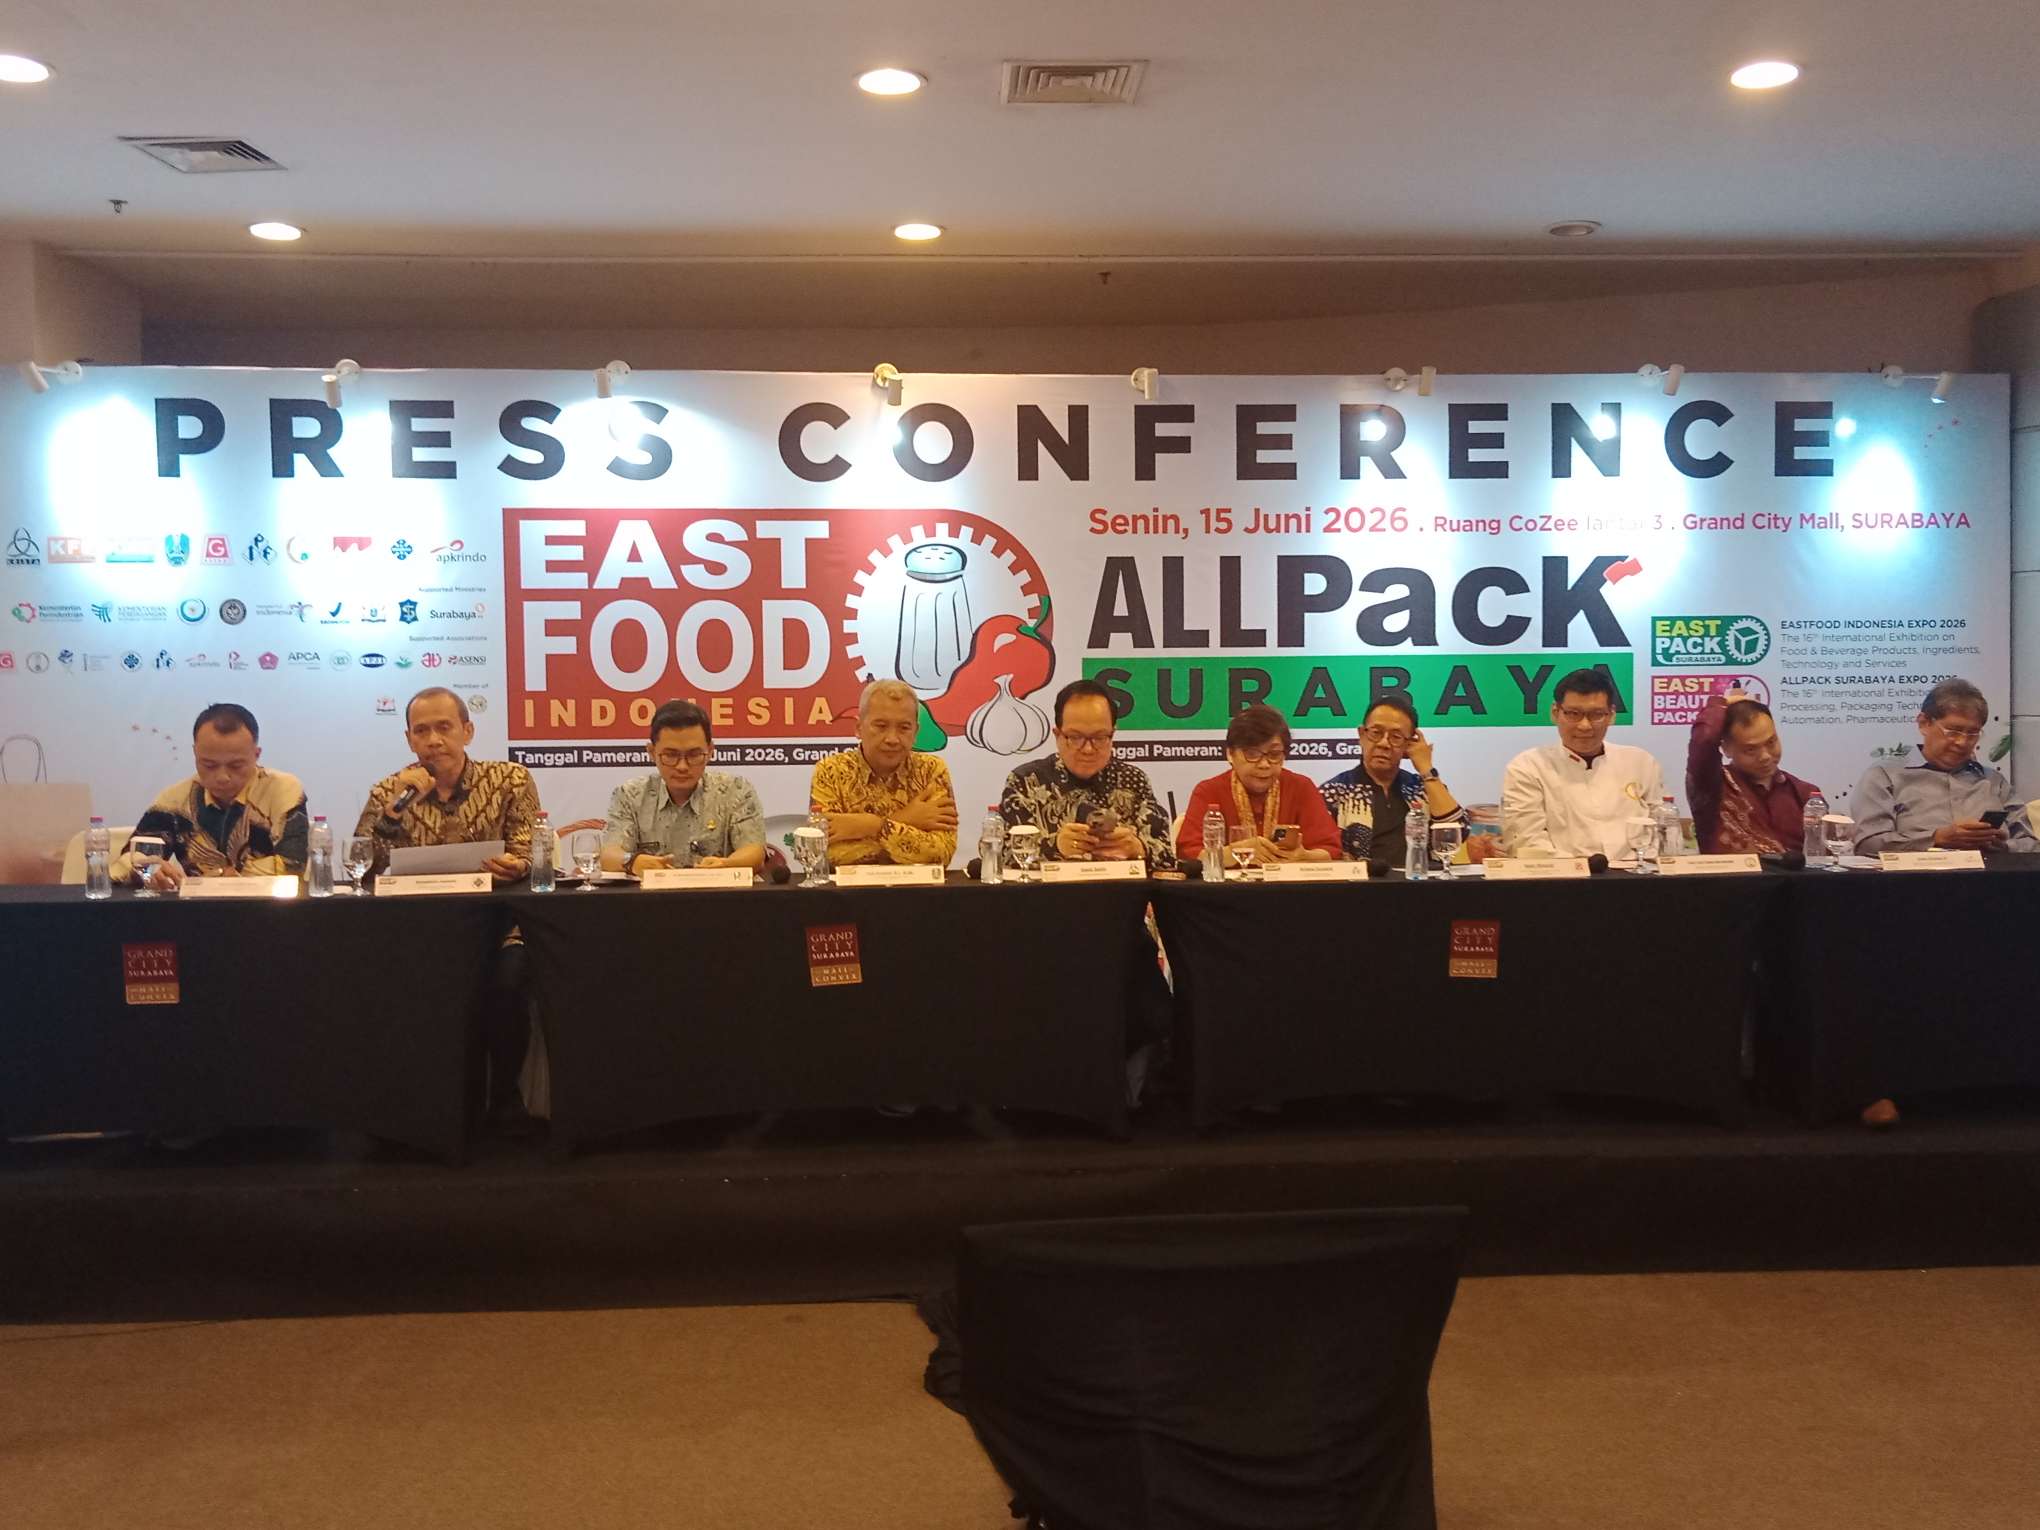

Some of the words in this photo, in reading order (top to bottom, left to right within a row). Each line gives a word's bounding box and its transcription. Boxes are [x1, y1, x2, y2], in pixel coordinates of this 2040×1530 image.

[155, 397, 673, 480] PRESS
[778, 400, 1835, 482] CONFERENCE
[1089, 507, 1189, 540] Senin,
[1199, 507, 1233, 535] 15
[1243, 506, 1311, 535] Juni
[1322, 506, 1409, 534] 2026
[1434, 515, 1501, 535] Ruang
[1508, 515, 1579, 532] CoZee
[1682, 512, 1745, 531] Grand
[1752, 512, 1792, 532] City
[1799, 512, 1845, 532] Mall,
[1852, 512, 1971, 529] SURABAYA
[436, 552, 487, 564] apkrindo
[519, 519, 830, 590] EAST
[430, 609, 477, 620] Surabaya
[1655, 620, 1722, 637] EAST
[1780, 620, 1841, 630] EASTFOOD
[1843, 619, 1905, 629] INDONESIA
[1907, 619, 1937, 629] EXPO
[1939, 618, 1967, 629] 2026
[1780, 632, 1800, 642] The
[1822, 632, 1886, 642] International
[1889, 632, 1940, 642] Exhibition
[1942, 633, 1956, 642] on
[523, 598, 831, 693] FOOD
[1655, 637, 1723, 654] PACK
[1780, 646, 1808, 656] Food
[1810, 646, 1818, 656] &
[1821, 646, 1870, 657] Beverage
[288, 652, 320, 661] APCA
[1675, 655, 1722, 663] SURABAYA
[1780, 659, 1839, 670] Technology
[1842, 659, 1862, 669] and
[1864, 658, 1908, 669] Services
[1653, 677, 1715, 693] EAST
[1780, 676, 1832, 685] ALLPACK
[1834, 675, 1896, 685] SURABAYA
[1898, 675, 1929, 684] EXPO
[1780, 689, 1800, 698] The
[1821, 688, 1886, 698] International
[1653, 694, 1710, 710] BEAUT
[1840, 701, 1894, 713] Packaging
[524, 697, 833, 728] INDOESIA
[1153, 744, 1223, 757] Pameran:
[1289, 742, 1333, 758] 2026,
[514, 750, 578, 766] Tanggal
[710, 749, 741, 762] Juni
[744, 747, 789, 763] 2026,
[811, 931, 853, 942] GRAND
[1454, 927, 1496, 936] GRAND
[811, 941, 853, 952] CITY
[812, 951, 855, 960] SURABAYA
